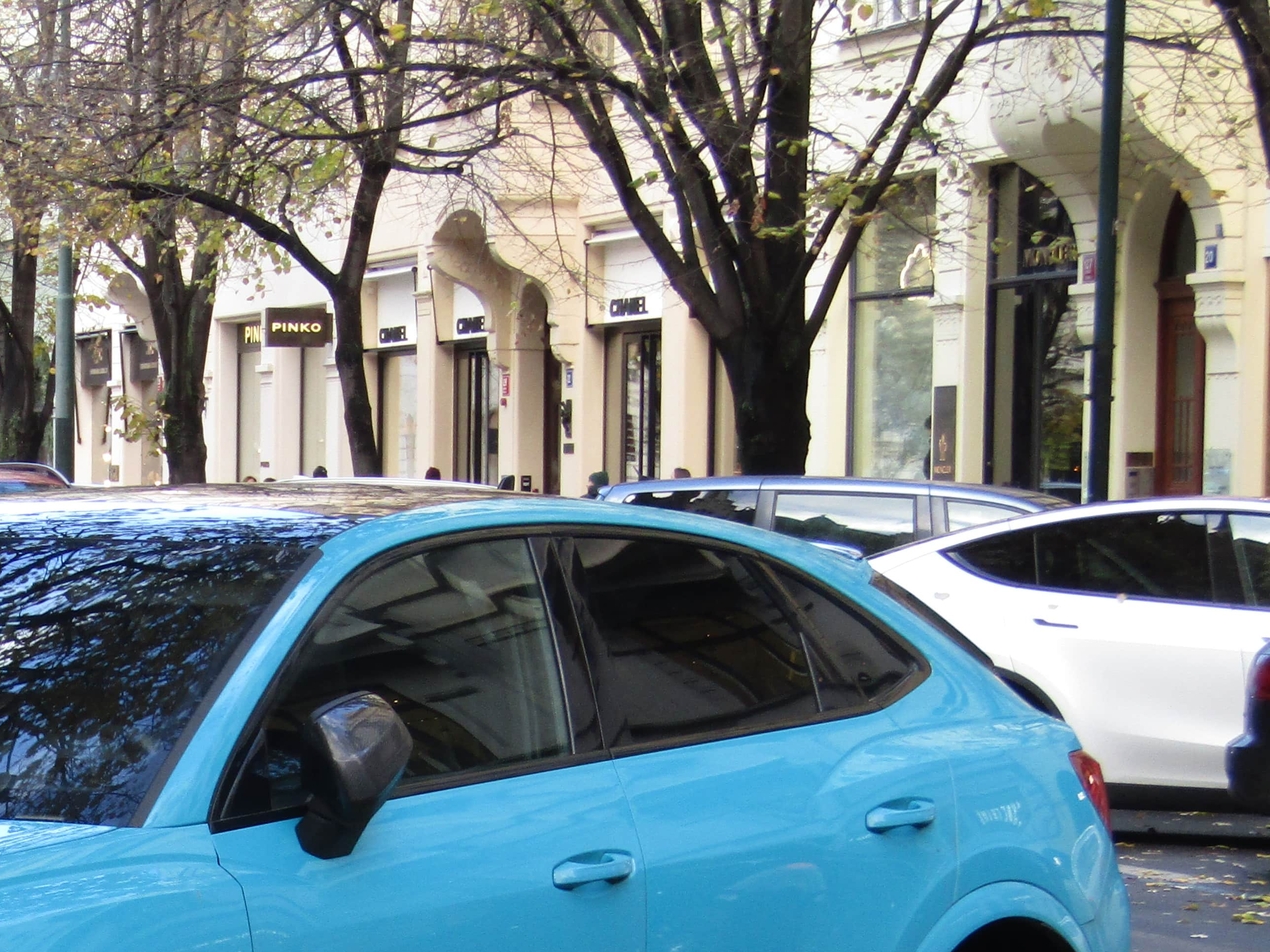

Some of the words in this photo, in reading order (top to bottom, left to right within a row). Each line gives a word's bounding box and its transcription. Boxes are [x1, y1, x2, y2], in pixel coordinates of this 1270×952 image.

[609, 296, 649, 317] CHANEL
[271, 322, 321, 333] PINKO
[379, 325, 408, 344] CHANEL
